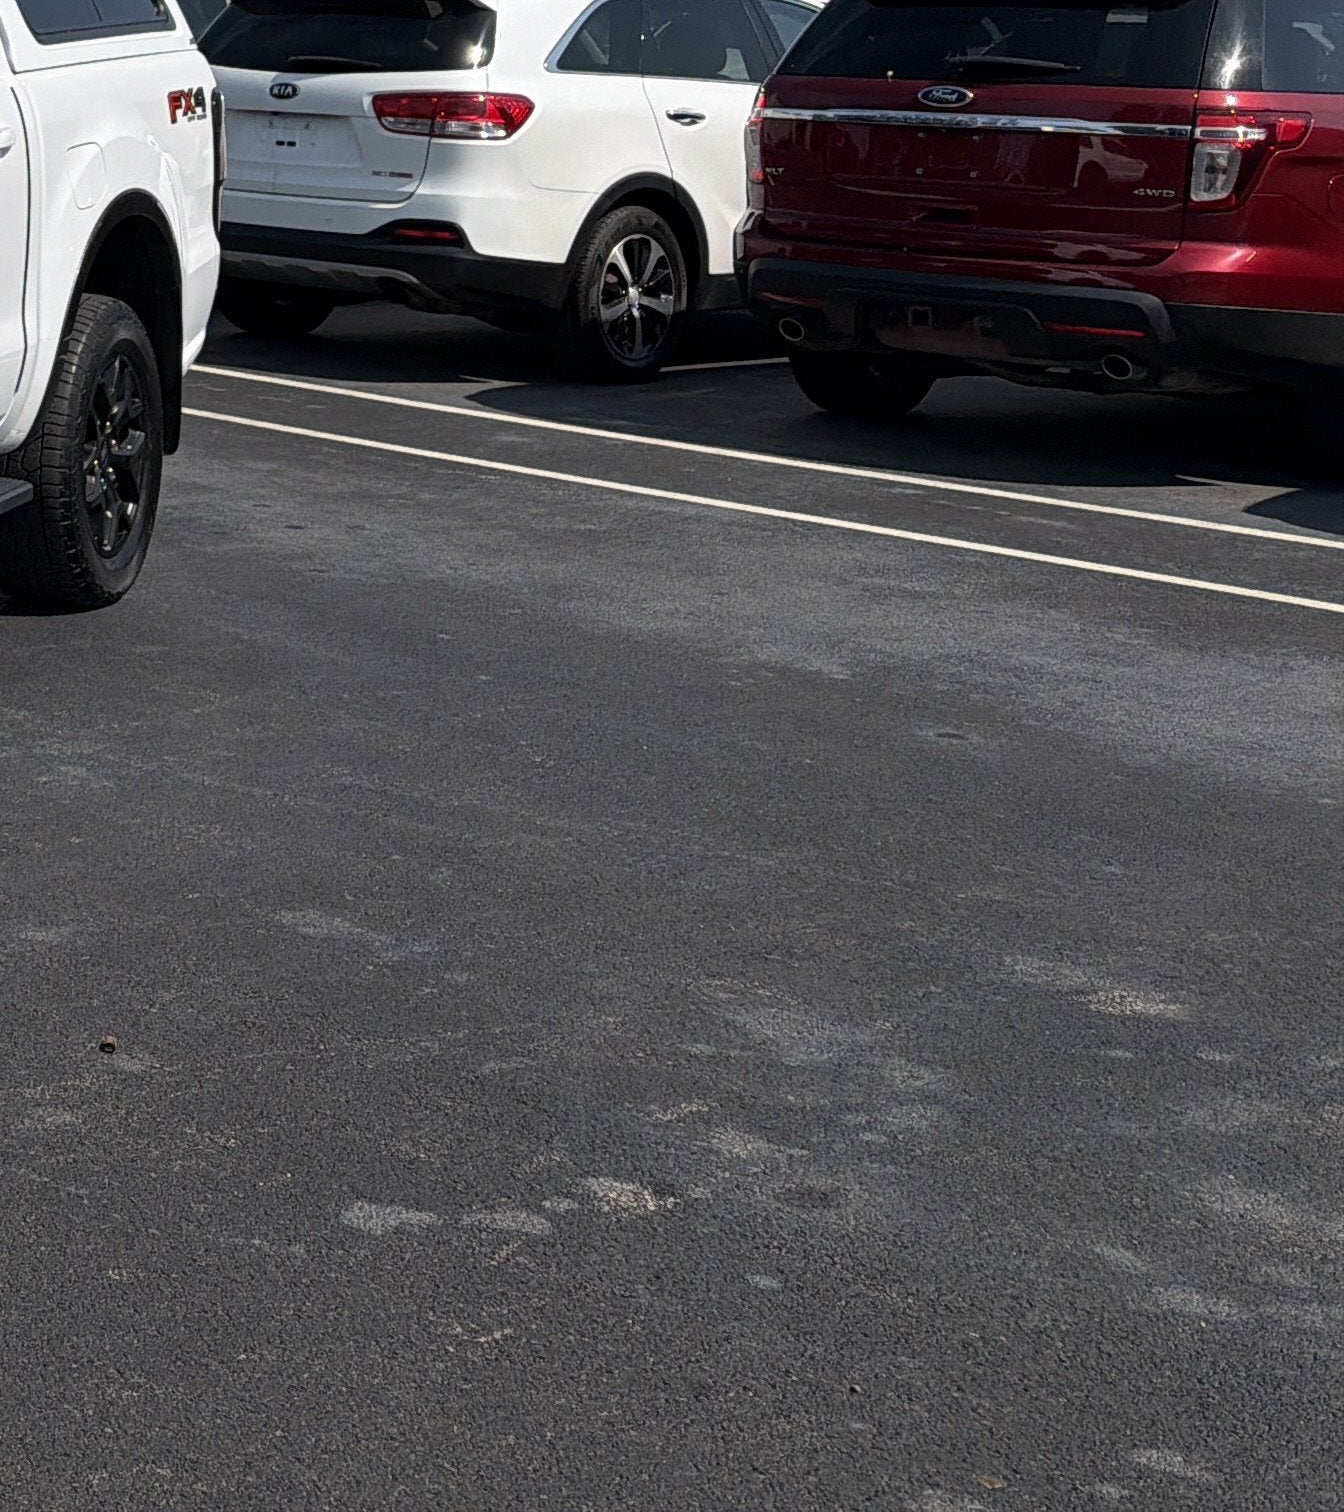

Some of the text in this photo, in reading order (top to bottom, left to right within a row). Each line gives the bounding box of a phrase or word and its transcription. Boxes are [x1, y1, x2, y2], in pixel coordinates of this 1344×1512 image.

[272, 84, 296, 97] KIA
[167, 86, 207, 125] FX4
[1132, 187, 1176, 198] 4WD
